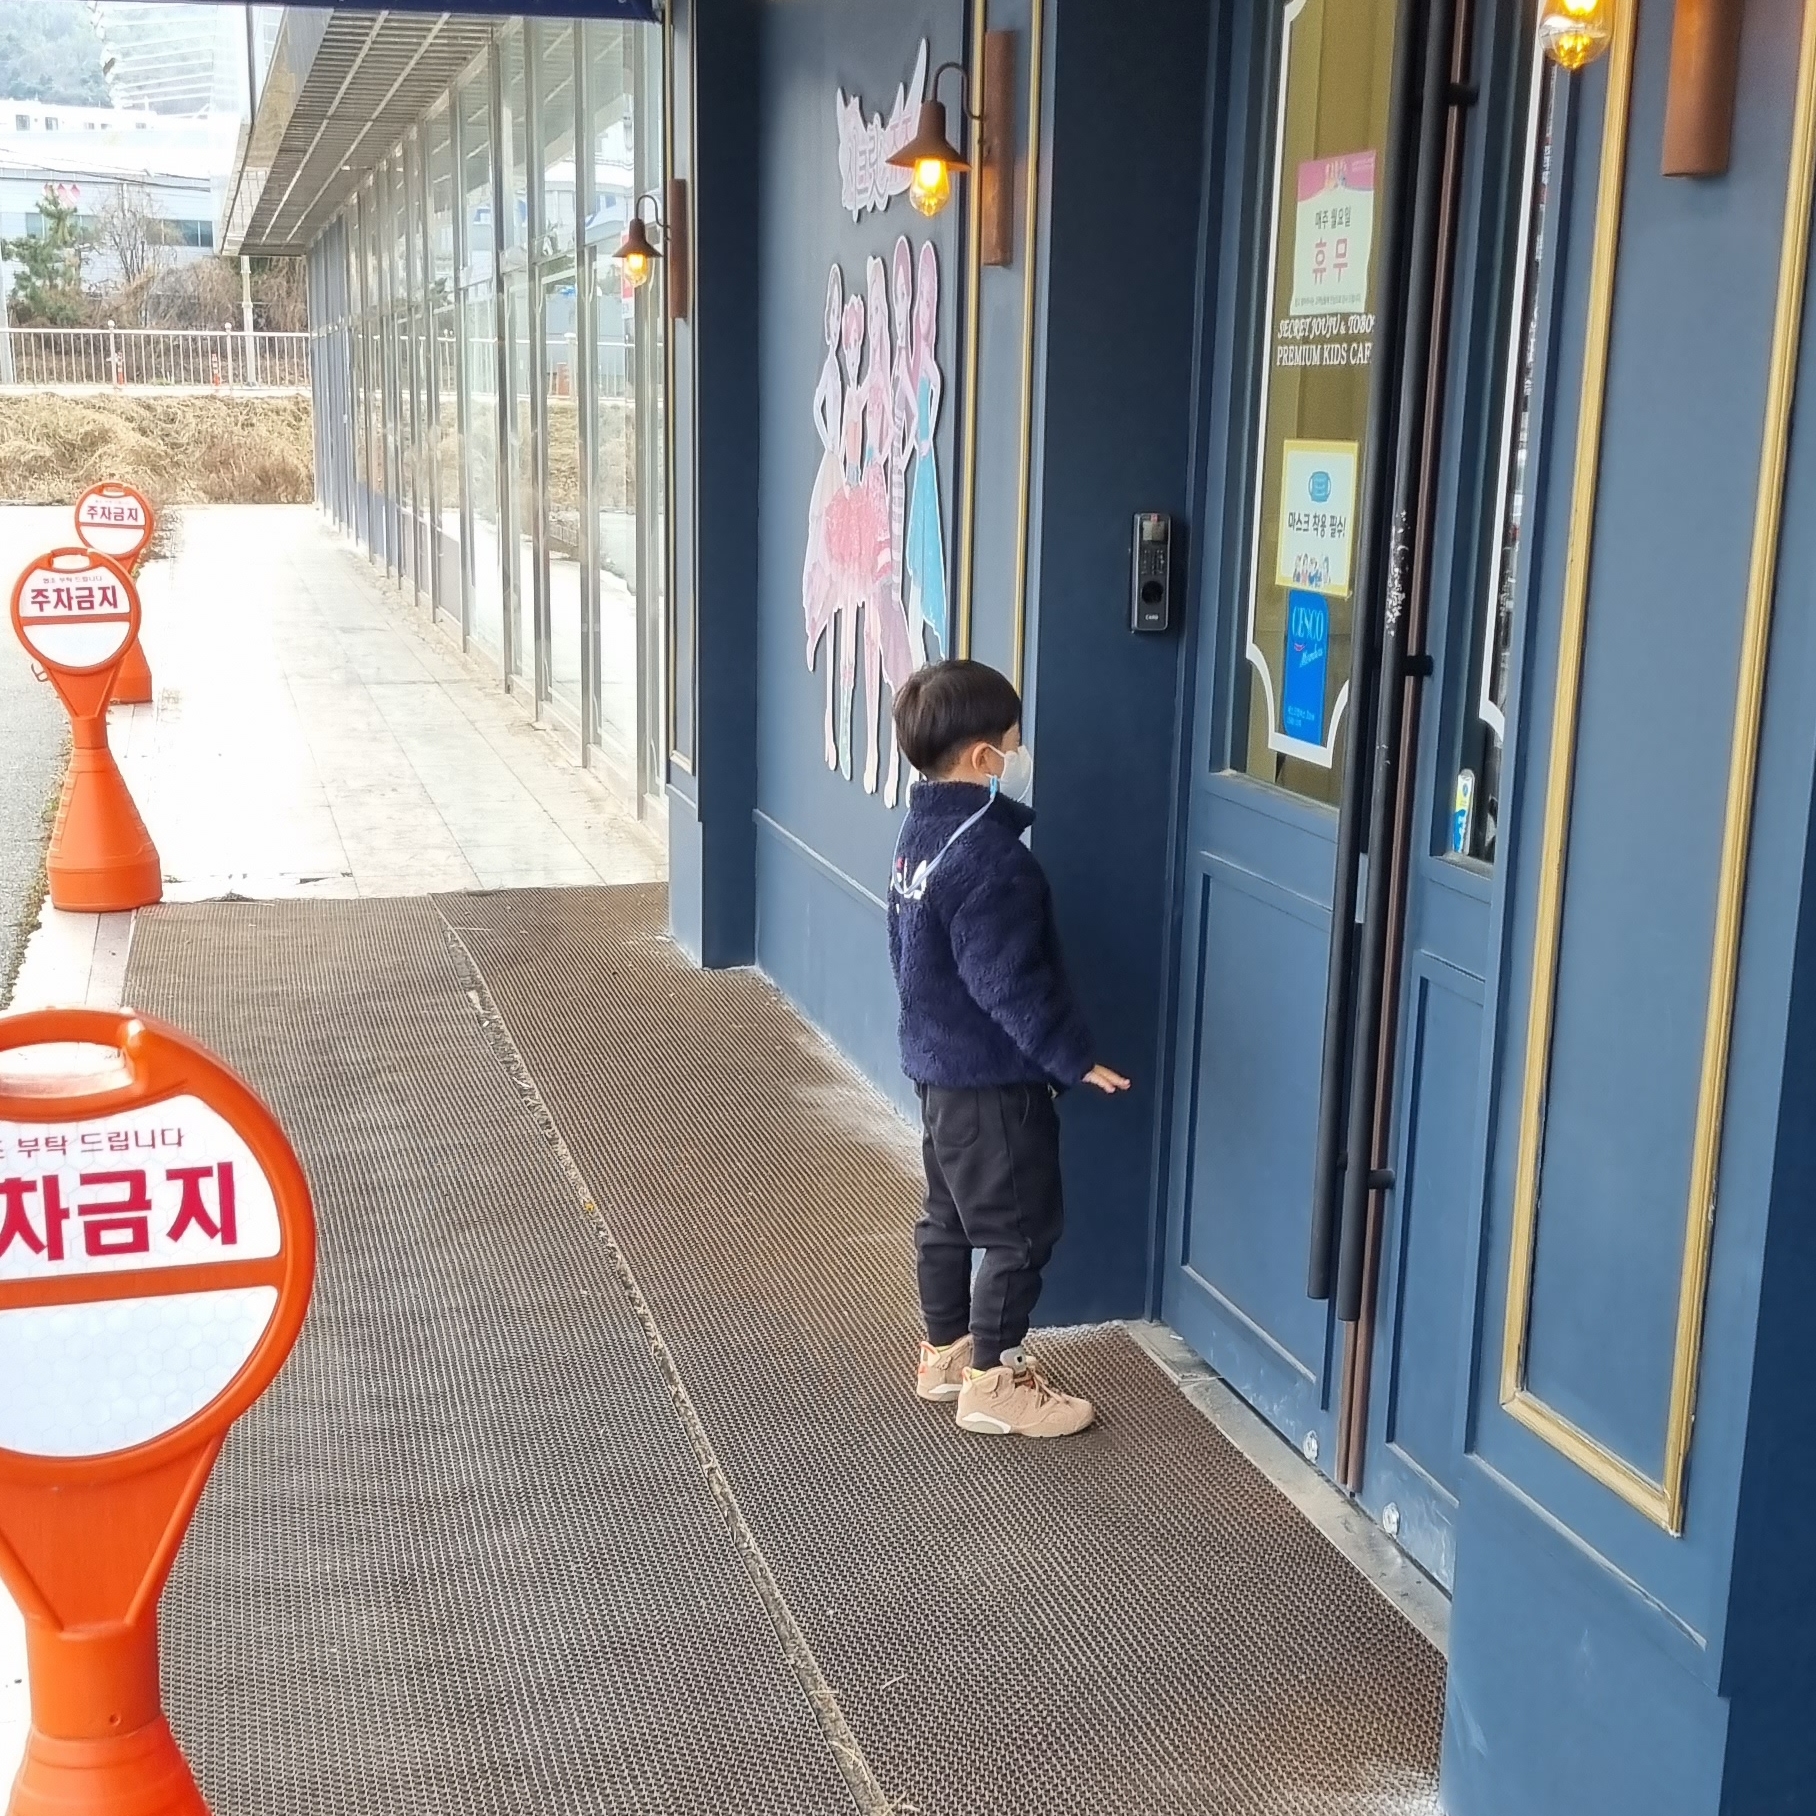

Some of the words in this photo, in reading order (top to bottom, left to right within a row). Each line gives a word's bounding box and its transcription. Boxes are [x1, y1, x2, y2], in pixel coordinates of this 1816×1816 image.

[1315, 210, 1329, 229] 매주
[1331, 206, 1351, 229] 월요일
[1312, 237, 1348, 285] 휴무
[1277, 316, 1312, 340] SECRET
[1276, 344, 1321, 366] PREMIUM
[1322, 342, 1348, 366] KIDS
[1349, 341, 1372, 365] CAF
[1288, 511, 1310, 533] 마스크
[1312, 512, 1327, 539] 착용
[1329, 514, 1347, 539] 필수!
[30, 584, 118, 613] 주차금지
[1292, 606, 1324, 641] CESCO
[17, 1134, 68, 1158] 부탁
[80, 1127, 185, 1154] 드립니다
[0, 1161, 238, 1262] 차금지
